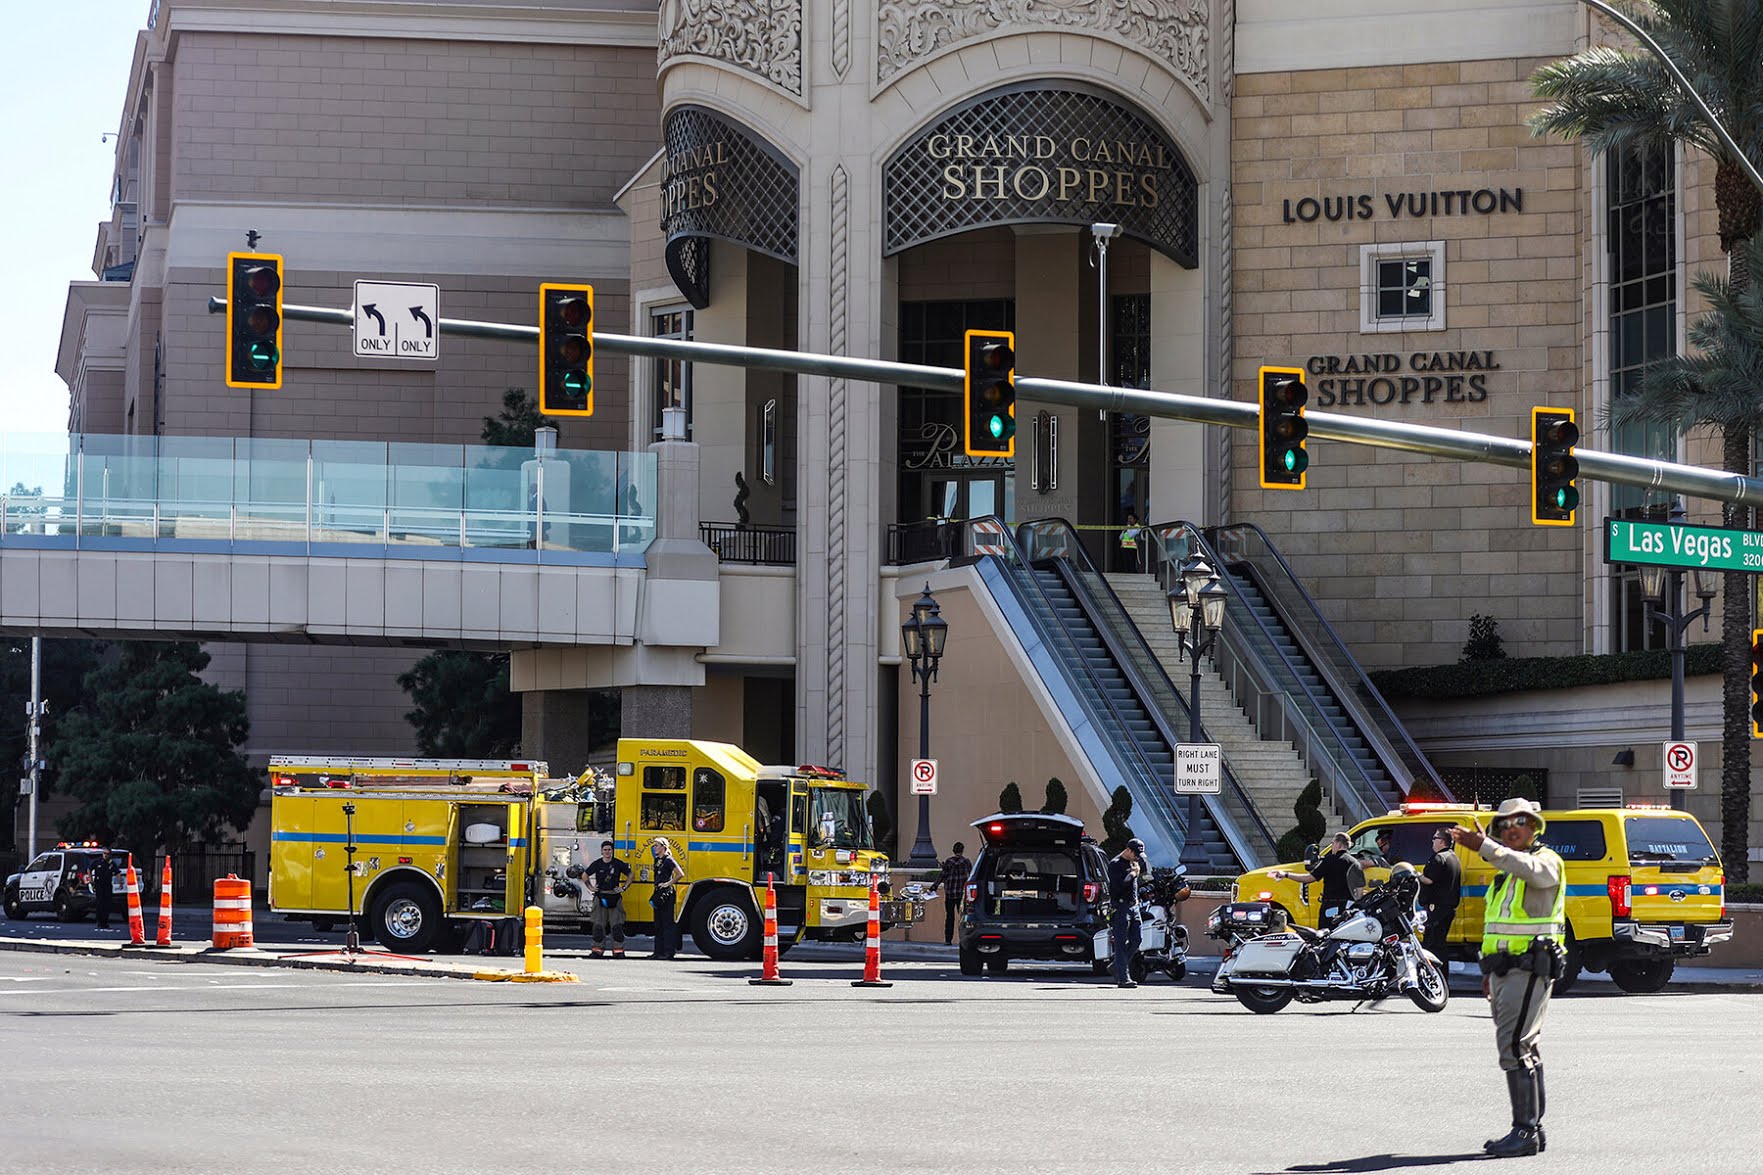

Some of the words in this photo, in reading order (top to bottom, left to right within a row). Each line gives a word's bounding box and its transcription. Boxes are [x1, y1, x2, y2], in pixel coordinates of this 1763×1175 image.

[928, 134, 1056, 160] GRAND
[1070, 138, 1172, 169] CANAL
[671, 141, 729, 176] CANAL
[943, 164, 1159, 208] SHOPPES
[1283, 194, 1374, 223] LOUIS
[1384, 187, 1522, 218] VUITTON
[361, 338, 391, 350] ONLY
[401, 340, 431, 352] ONLY
[1306, 353, 1400, 375] GRAND
[1409, 350, 1500, 372] CANAL
[1317, 374, 1487, 406] SHOPPES
[1612, 523, 1619, 536] S
[1629, 523, 1664, 553] Las
[1670, 527, 1732, 566] Vegas
[1743, 553, 1763, 566] 320
[640, 749, 688, 757] PARAMEDIC
[1178, 750, 1198, 758] RIGHT
[1200, 750, 1218, 759] LANE
[1186, 763, 1209, 773] MUST
[1178, 778, 1196, 787] TURN
[1198, 778, 1218, 787] RIGHT
[667, 837, 688, 860] OUNTY
[1648, 844, 1689, 854] BATTALION
[20, 889, 45, 900] POLICE
